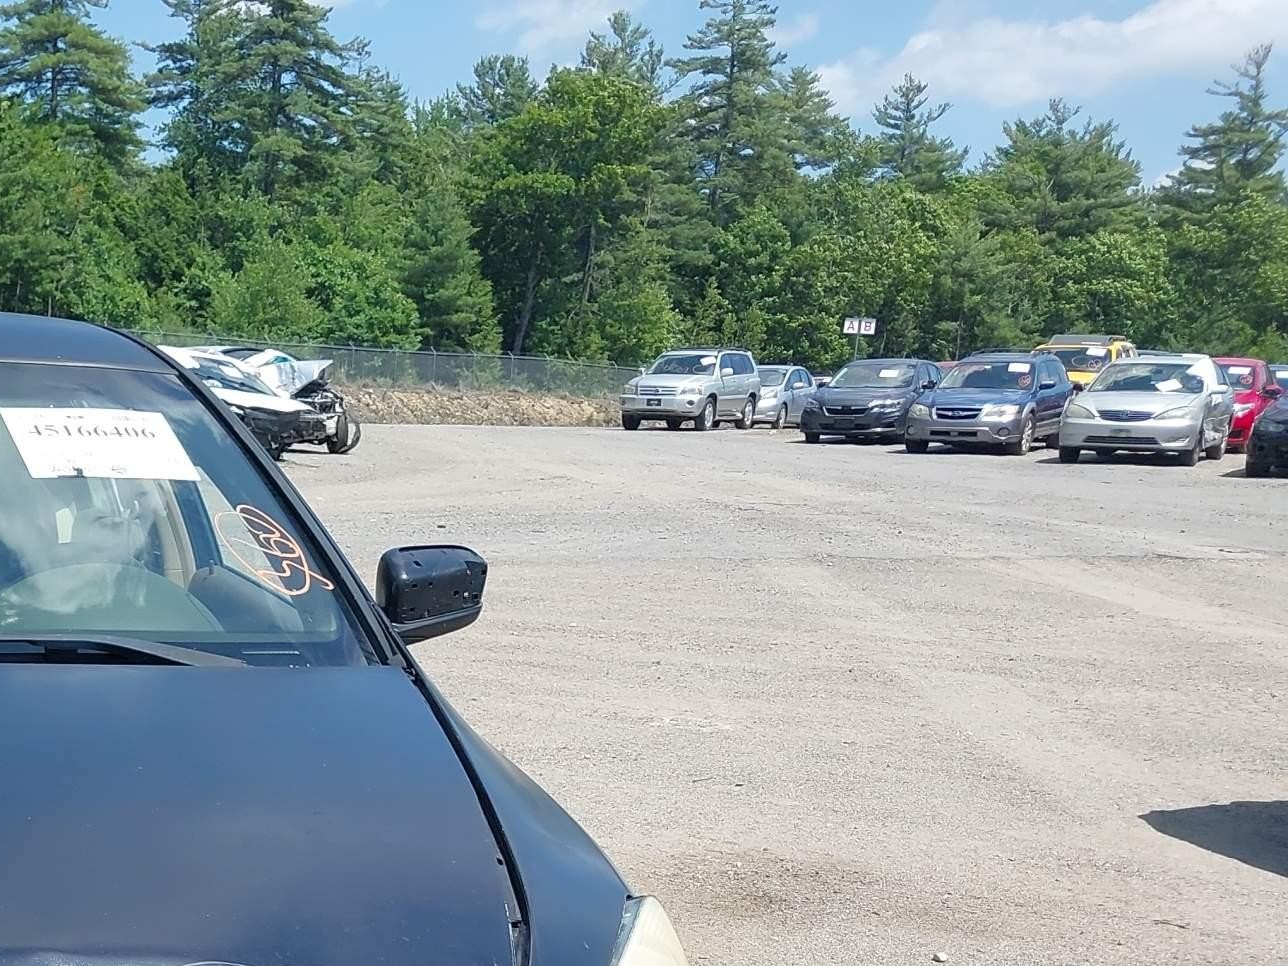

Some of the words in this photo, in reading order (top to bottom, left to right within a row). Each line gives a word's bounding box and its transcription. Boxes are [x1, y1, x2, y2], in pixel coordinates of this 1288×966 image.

[846, 320, 855, 331] A
[863, 321, 872, 331] B
[27, 423, 156, 439] 45166406
